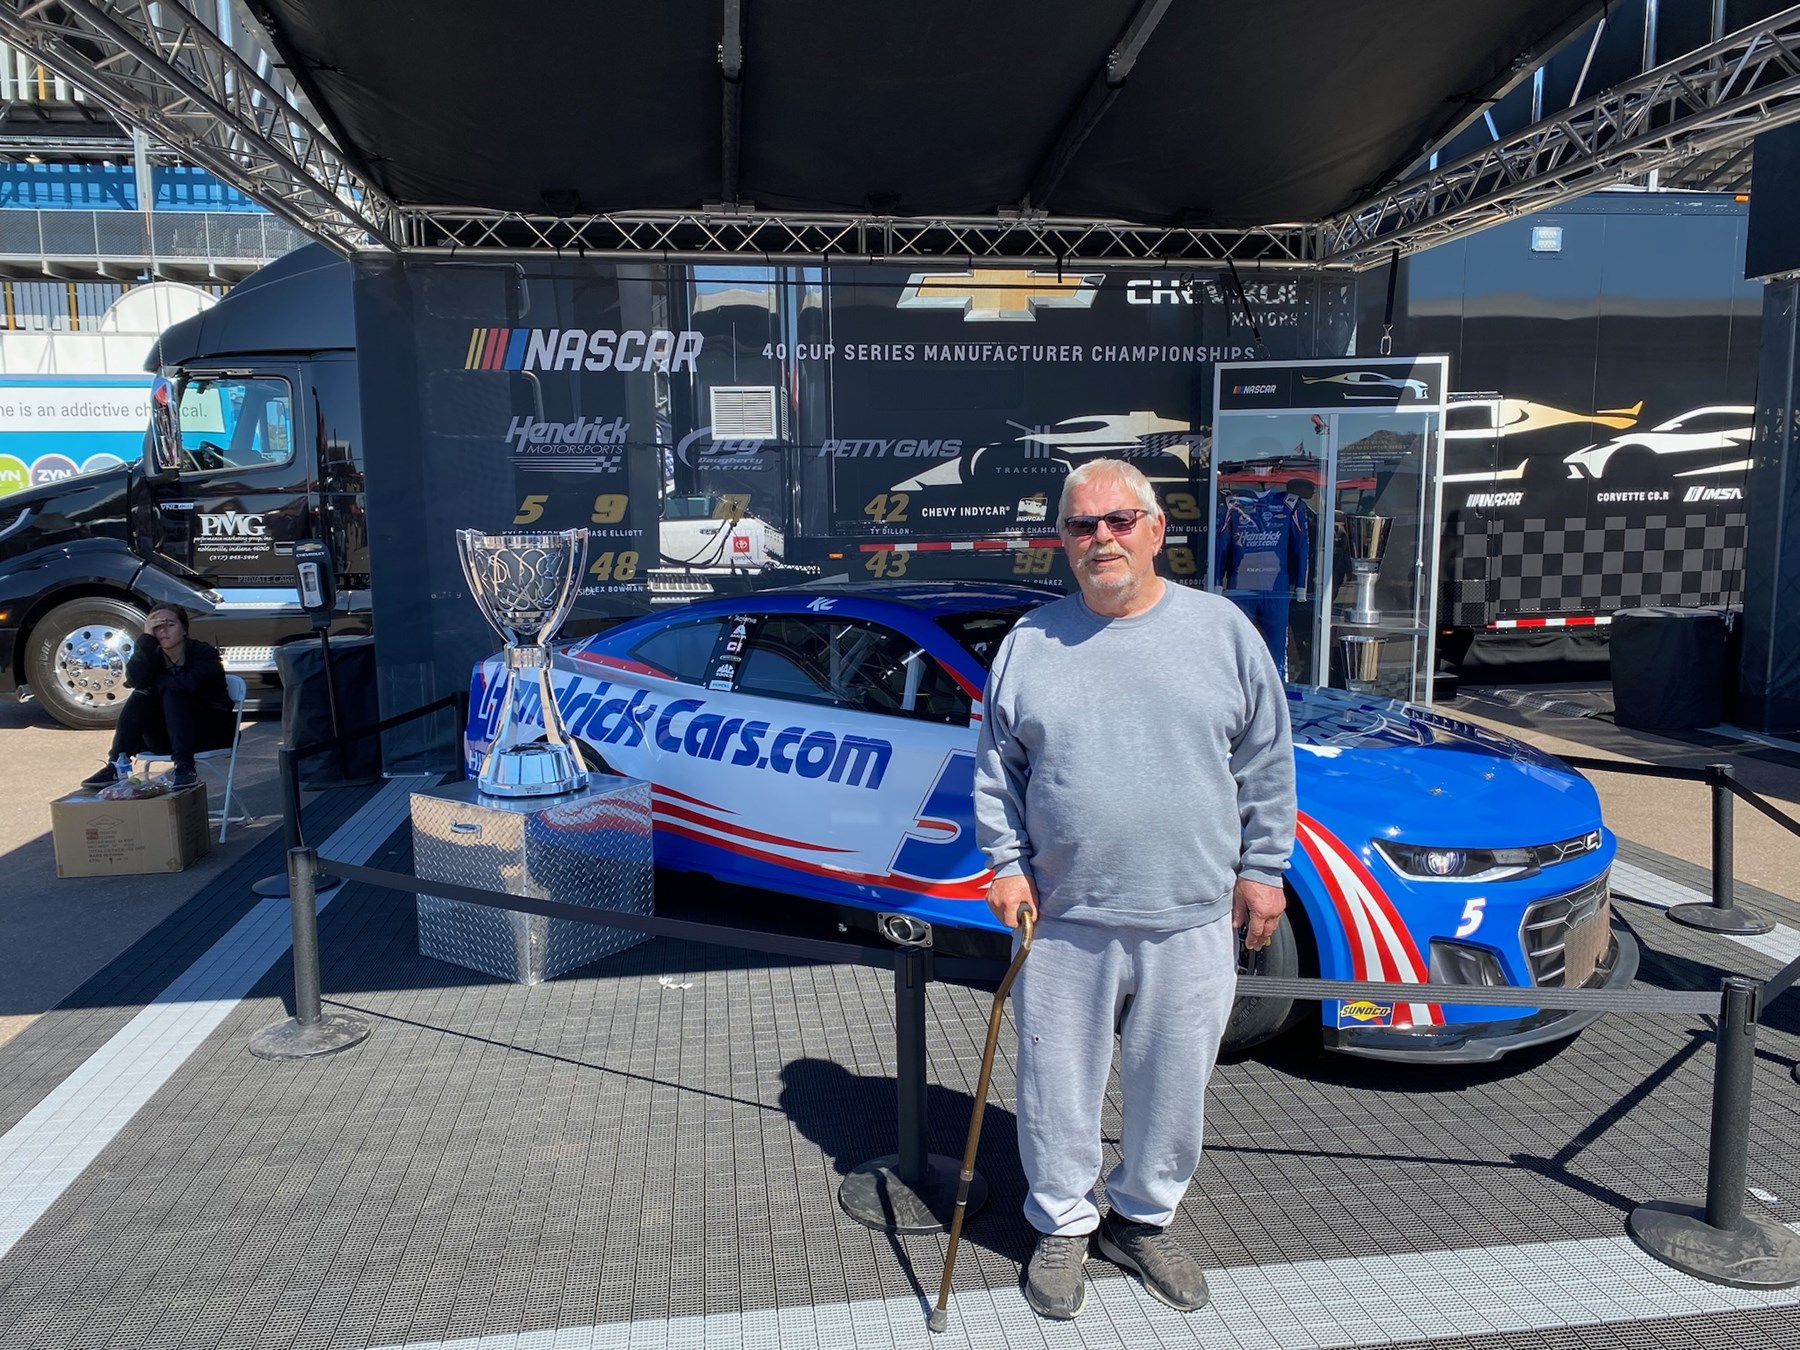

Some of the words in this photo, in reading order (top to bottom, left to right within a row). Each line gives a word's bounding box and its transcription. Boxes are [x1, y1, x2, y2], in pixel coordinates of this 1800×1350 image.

[524, 328, 705, 373] NASCAR
[762, 343, 786, 360] 40
[796, 343, 836, 360] CUP
[844, 344, 915, 361] SERIES
[924, 344, 1083, 362] MANUFACTURER
[1092, 345, 1255, 362] CHAMPIONSHIPS
[1244, 384, 1277, 394] NASCAR
[19, 402, 32, 417] is
[38, 406, 55, 417] an
[61, 402, 129, 417] addictive
[505, 415, 631, 453] Hendrick
[526, 444, 624, 454] MOTORSPORTS
[697, 457, 764, 465] Daugherty
[37, 469, 72, 482] ZYN
[995, 466, 1068, 474] TRACKHOU
[1596, 492, 1646, 502] CORVETTE
[1701, 487, 1744, 500] IMSA
[513, 495, 549, 525] 5
[591, 494, 629, 524] 9
[864, 493, 910, 522] 42
[921, 507, 957, 518] CHEVY
[1166, 493, 1200, 520] 3
[200, 511, 266, 536] PMG
[883, 527, 910, 535] DILLON
[588, 529, 606, 537] HASE
[610, 529, 643, 537] ELLIOTT
[1240, 530, 1282, 545] Hendrick
[589, 550, 639, 581] 48
[864, 550, 910, 578] 43
[1012, 549, 1055, 574] 99
[1166, 547, 1197, 575] 8
[238, 575, 273, 584] PRIVATE
[275, 575, 296, 584] CARR
[608, 585, 644, 593] BOWMAN
[887, 748, 996, 884] 5
[1455, 897, 1486, 938] 5
[1342, 1006, 1388, 1016] SUNOCO
